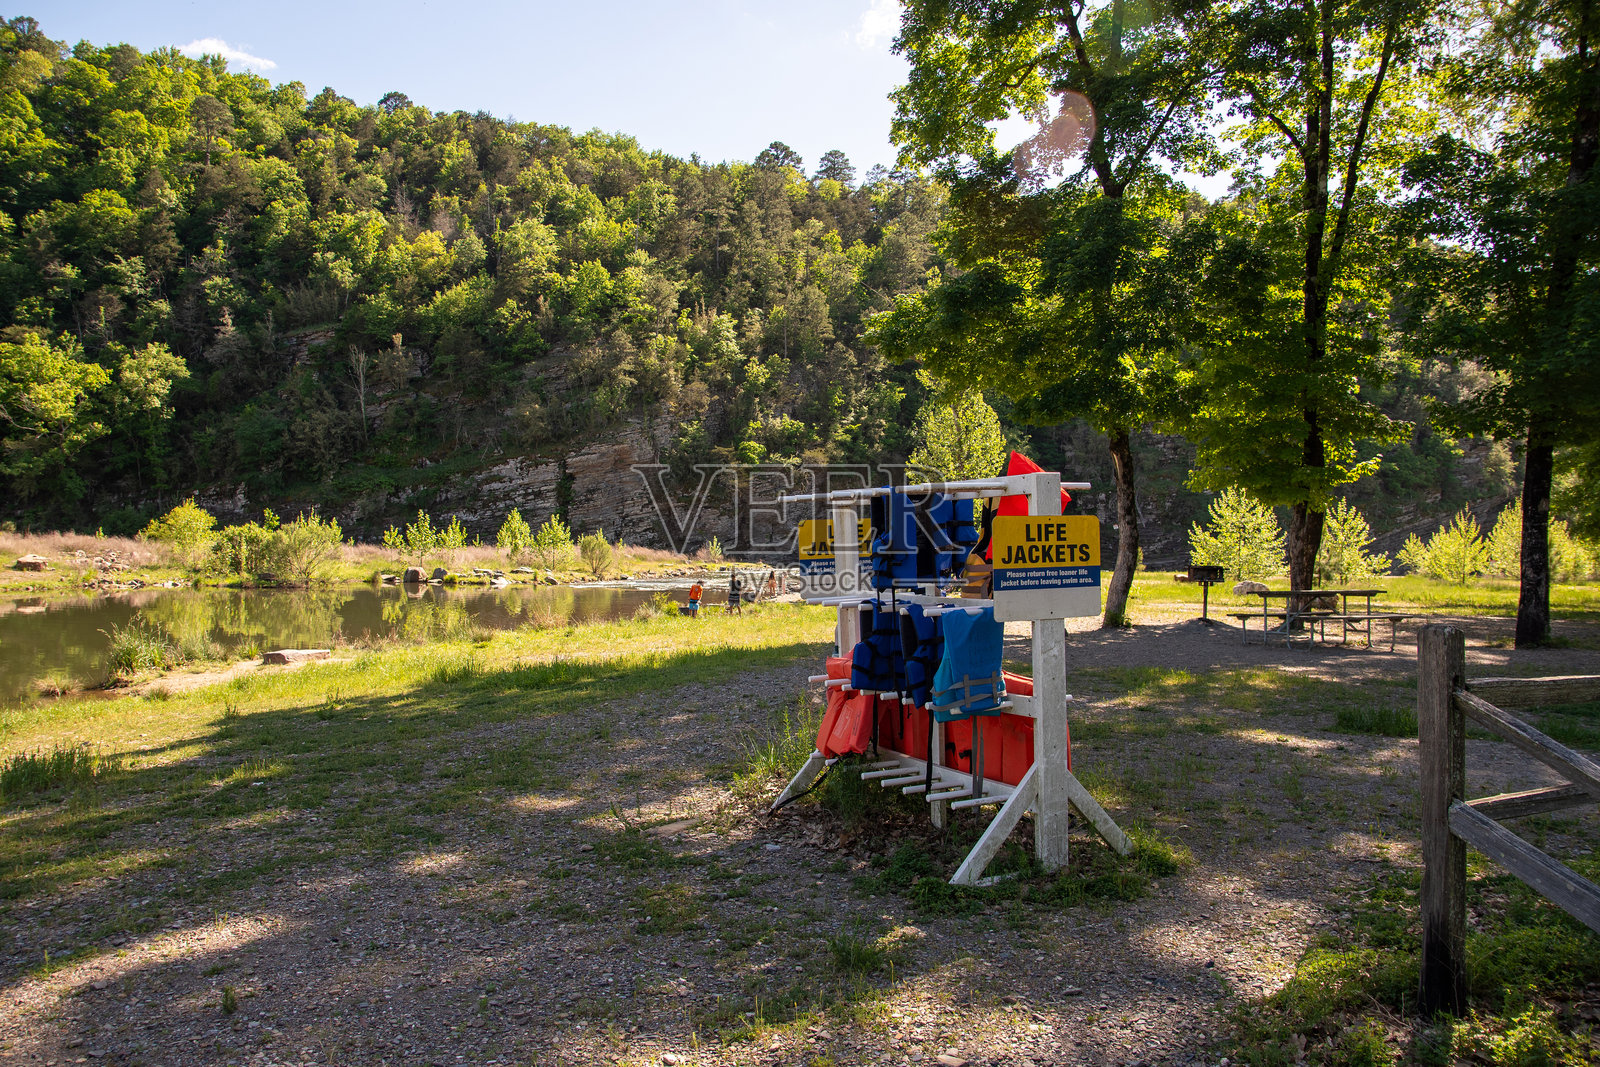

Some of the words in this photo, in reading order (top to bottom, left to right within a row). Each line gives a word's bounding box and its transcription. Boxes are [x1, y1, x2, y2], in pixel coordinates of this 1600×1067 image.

[828, 524, 863, 539] LE
[1025, 523, 1067, 542] LIFE
[1001, 544, 1091, 565] JACKETS
[1000, 579, 1020, 588] jacket
[1020, 578, 1040, 586] before
[1040, 577, 1061, 586] leaving
[1078, 576, 1094, 584] area.
